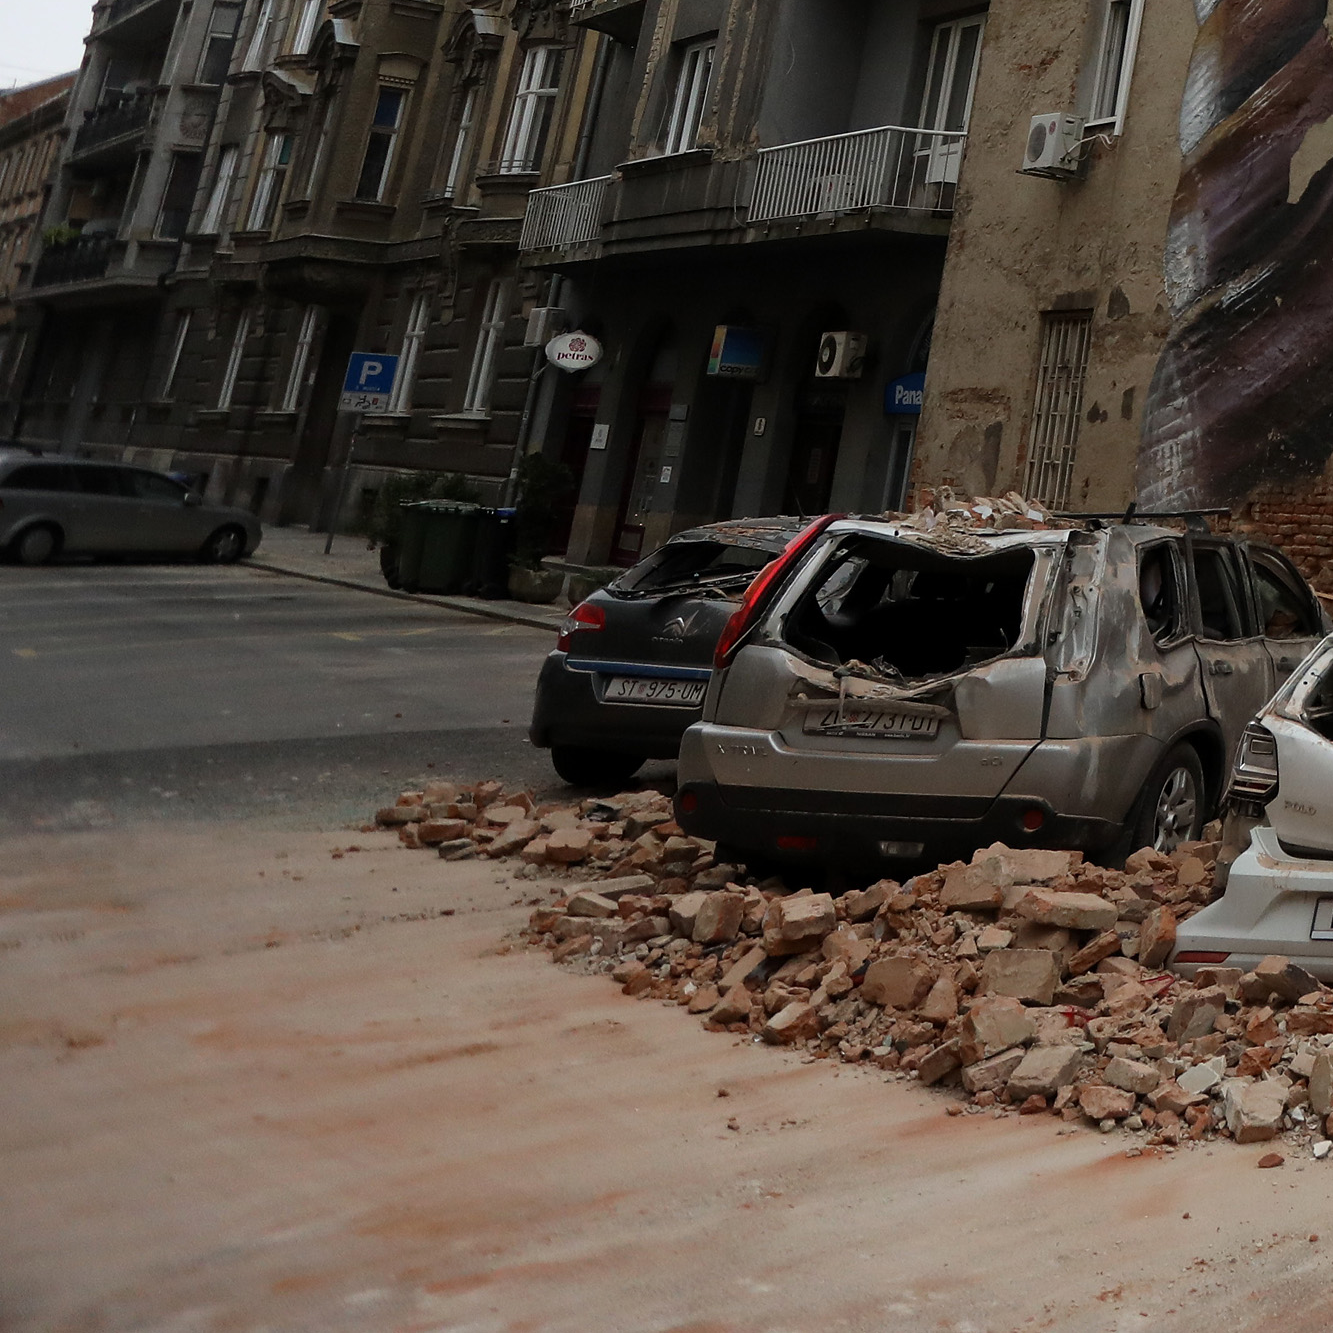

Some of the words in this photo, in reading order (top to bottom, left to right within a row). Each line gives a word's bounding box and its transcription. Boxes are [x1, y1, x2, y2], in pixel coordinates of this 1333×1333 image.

[557, 352, 594, 361] petras
[359, 360, 383, 385] P
[618, 680, 638, 696] ST
[646, 681, 704, 700] 975-UM
